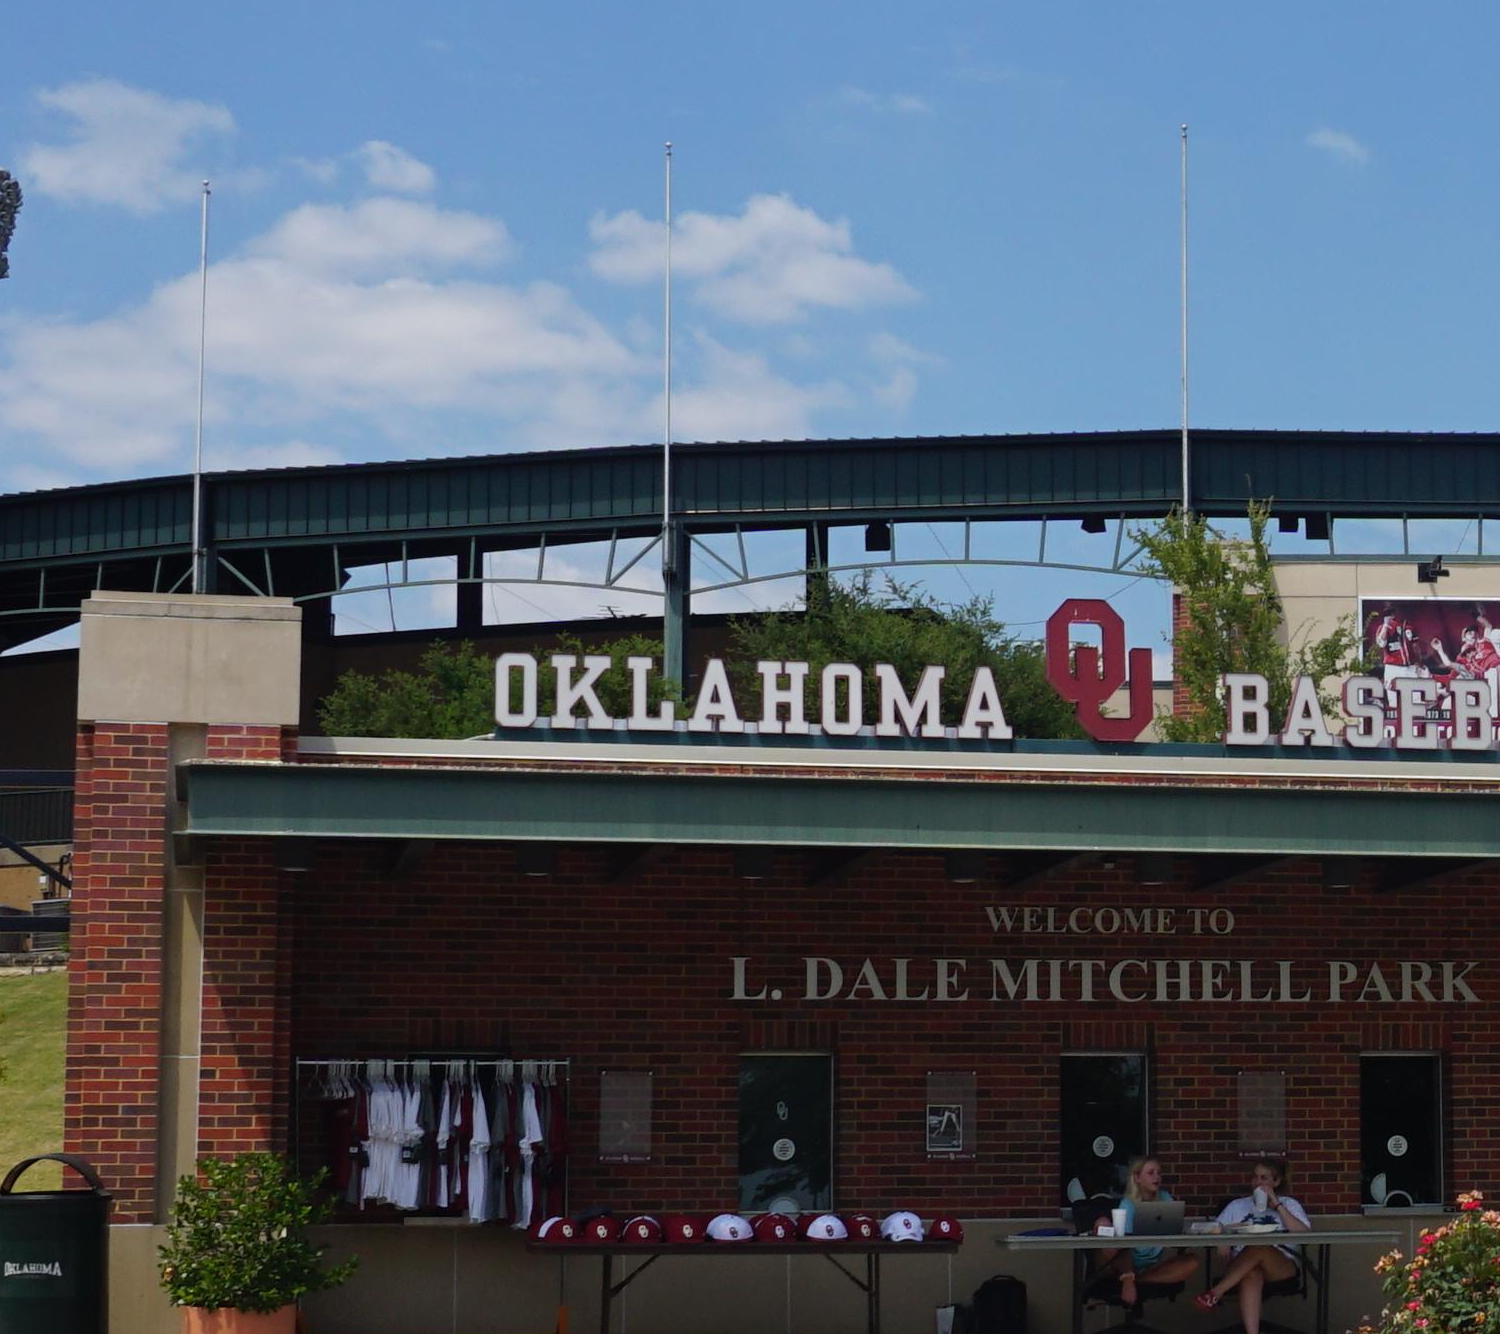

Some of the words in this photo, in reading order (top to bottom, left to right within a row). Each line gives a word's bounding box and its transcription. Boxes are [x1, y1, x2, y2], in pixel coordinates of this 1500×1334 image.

[494, 652, 1014, 740] OKLAHOMA
[1045, 597, 1153, 742] OU
[985, 906, 1177, 935] WELCOME
[1187, 907, 1235, 935] TO
[728, 956, 783, 1002] L.
[800, 956, 970, 1002] DALE
[991, 958, 1312, 1003] MITCHELL
[1326, 961, 1482, 1003] PARK
[3, 1261, 63, 1277] OKLAHOMA
